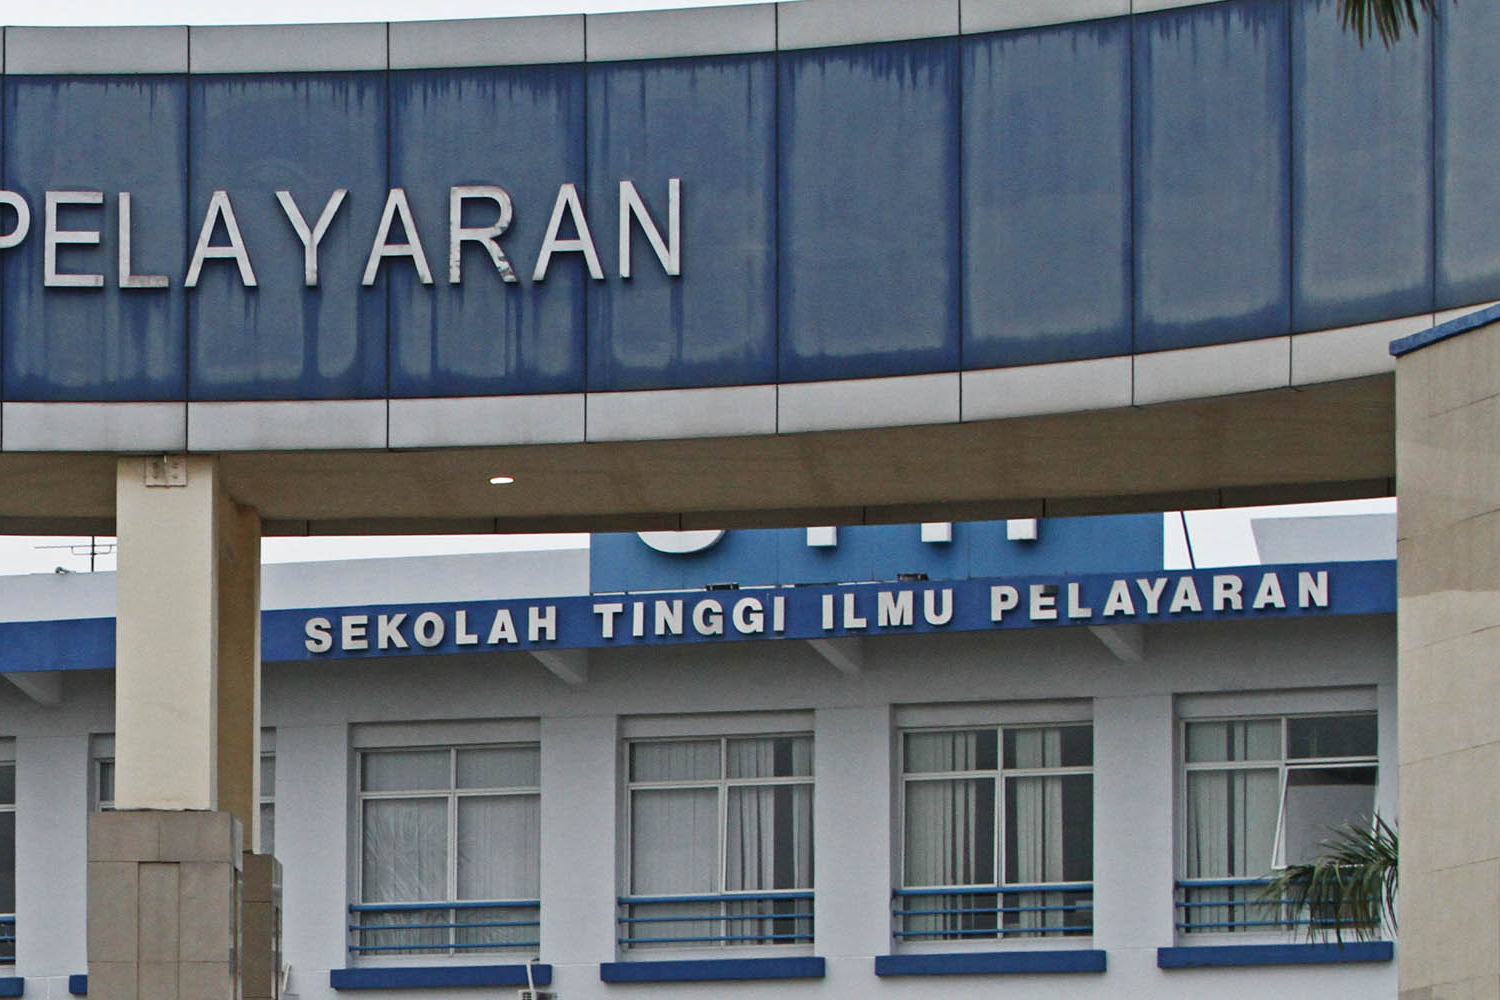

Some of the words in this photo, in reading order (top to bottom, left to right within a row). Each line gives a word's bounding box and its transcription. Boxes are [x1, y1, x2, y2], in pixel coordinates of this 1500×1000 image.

[305, 605, 556, 653] SEKOLAH
[593, 595, 785, 639] TINGGI
[822, 588, 954, 630] ILMU
[990, 570, 1329, 622] PELAYARAN
